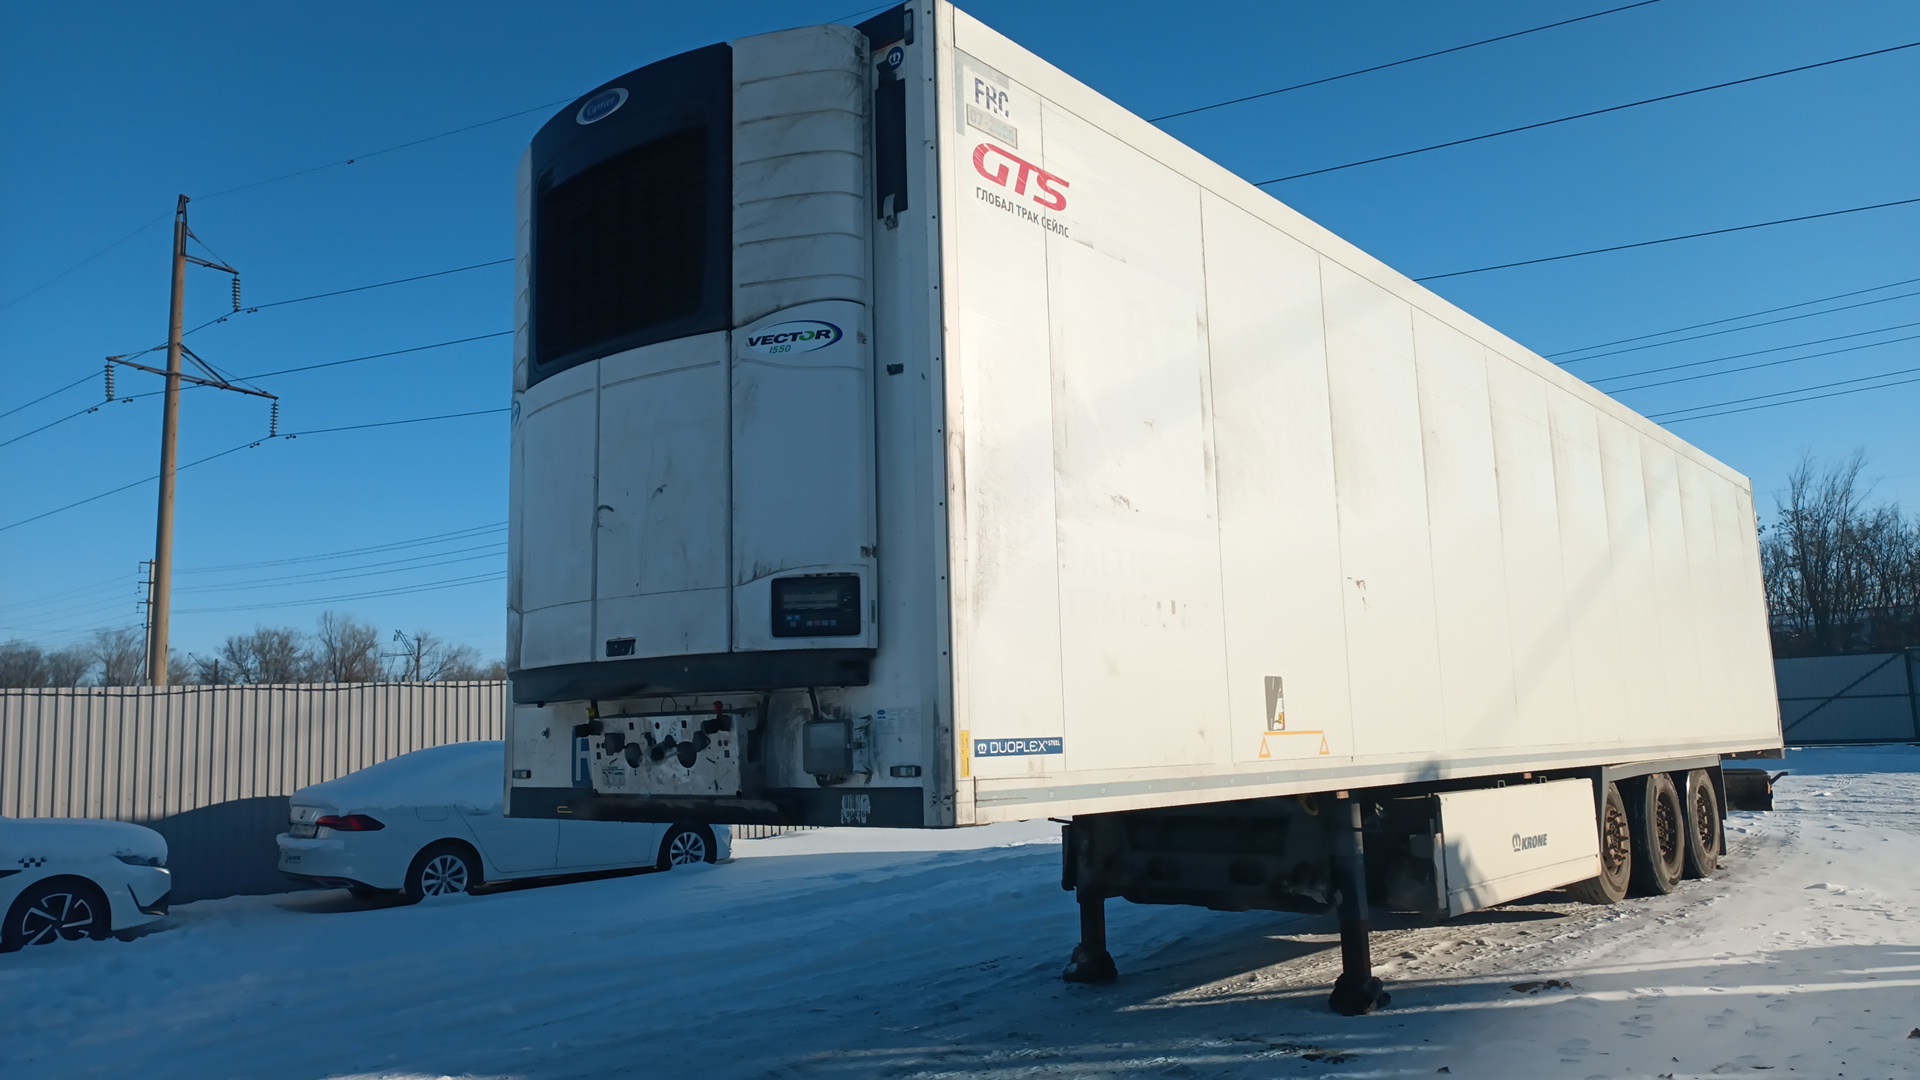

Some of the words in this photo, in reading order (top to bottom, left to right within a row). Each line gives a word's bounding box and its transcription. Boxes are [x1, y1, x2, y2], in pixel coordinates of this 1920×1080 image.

[587, 96, 616, 116] Carrier
[975, 77, 1009, 118] FRC
[973, 143, 1070, 211] GTS
[976, 186, 1014, 214] ГЛОБАЛ
[1016, 204, 1040, 225] ТРАК
[1041, 216, 1070, 238] СЕЙЛС
[748, 329, 832, 347] VECTOR
[769, 344, 792, 354] 1550
[1521, 833, 1548, 850] KRONE
